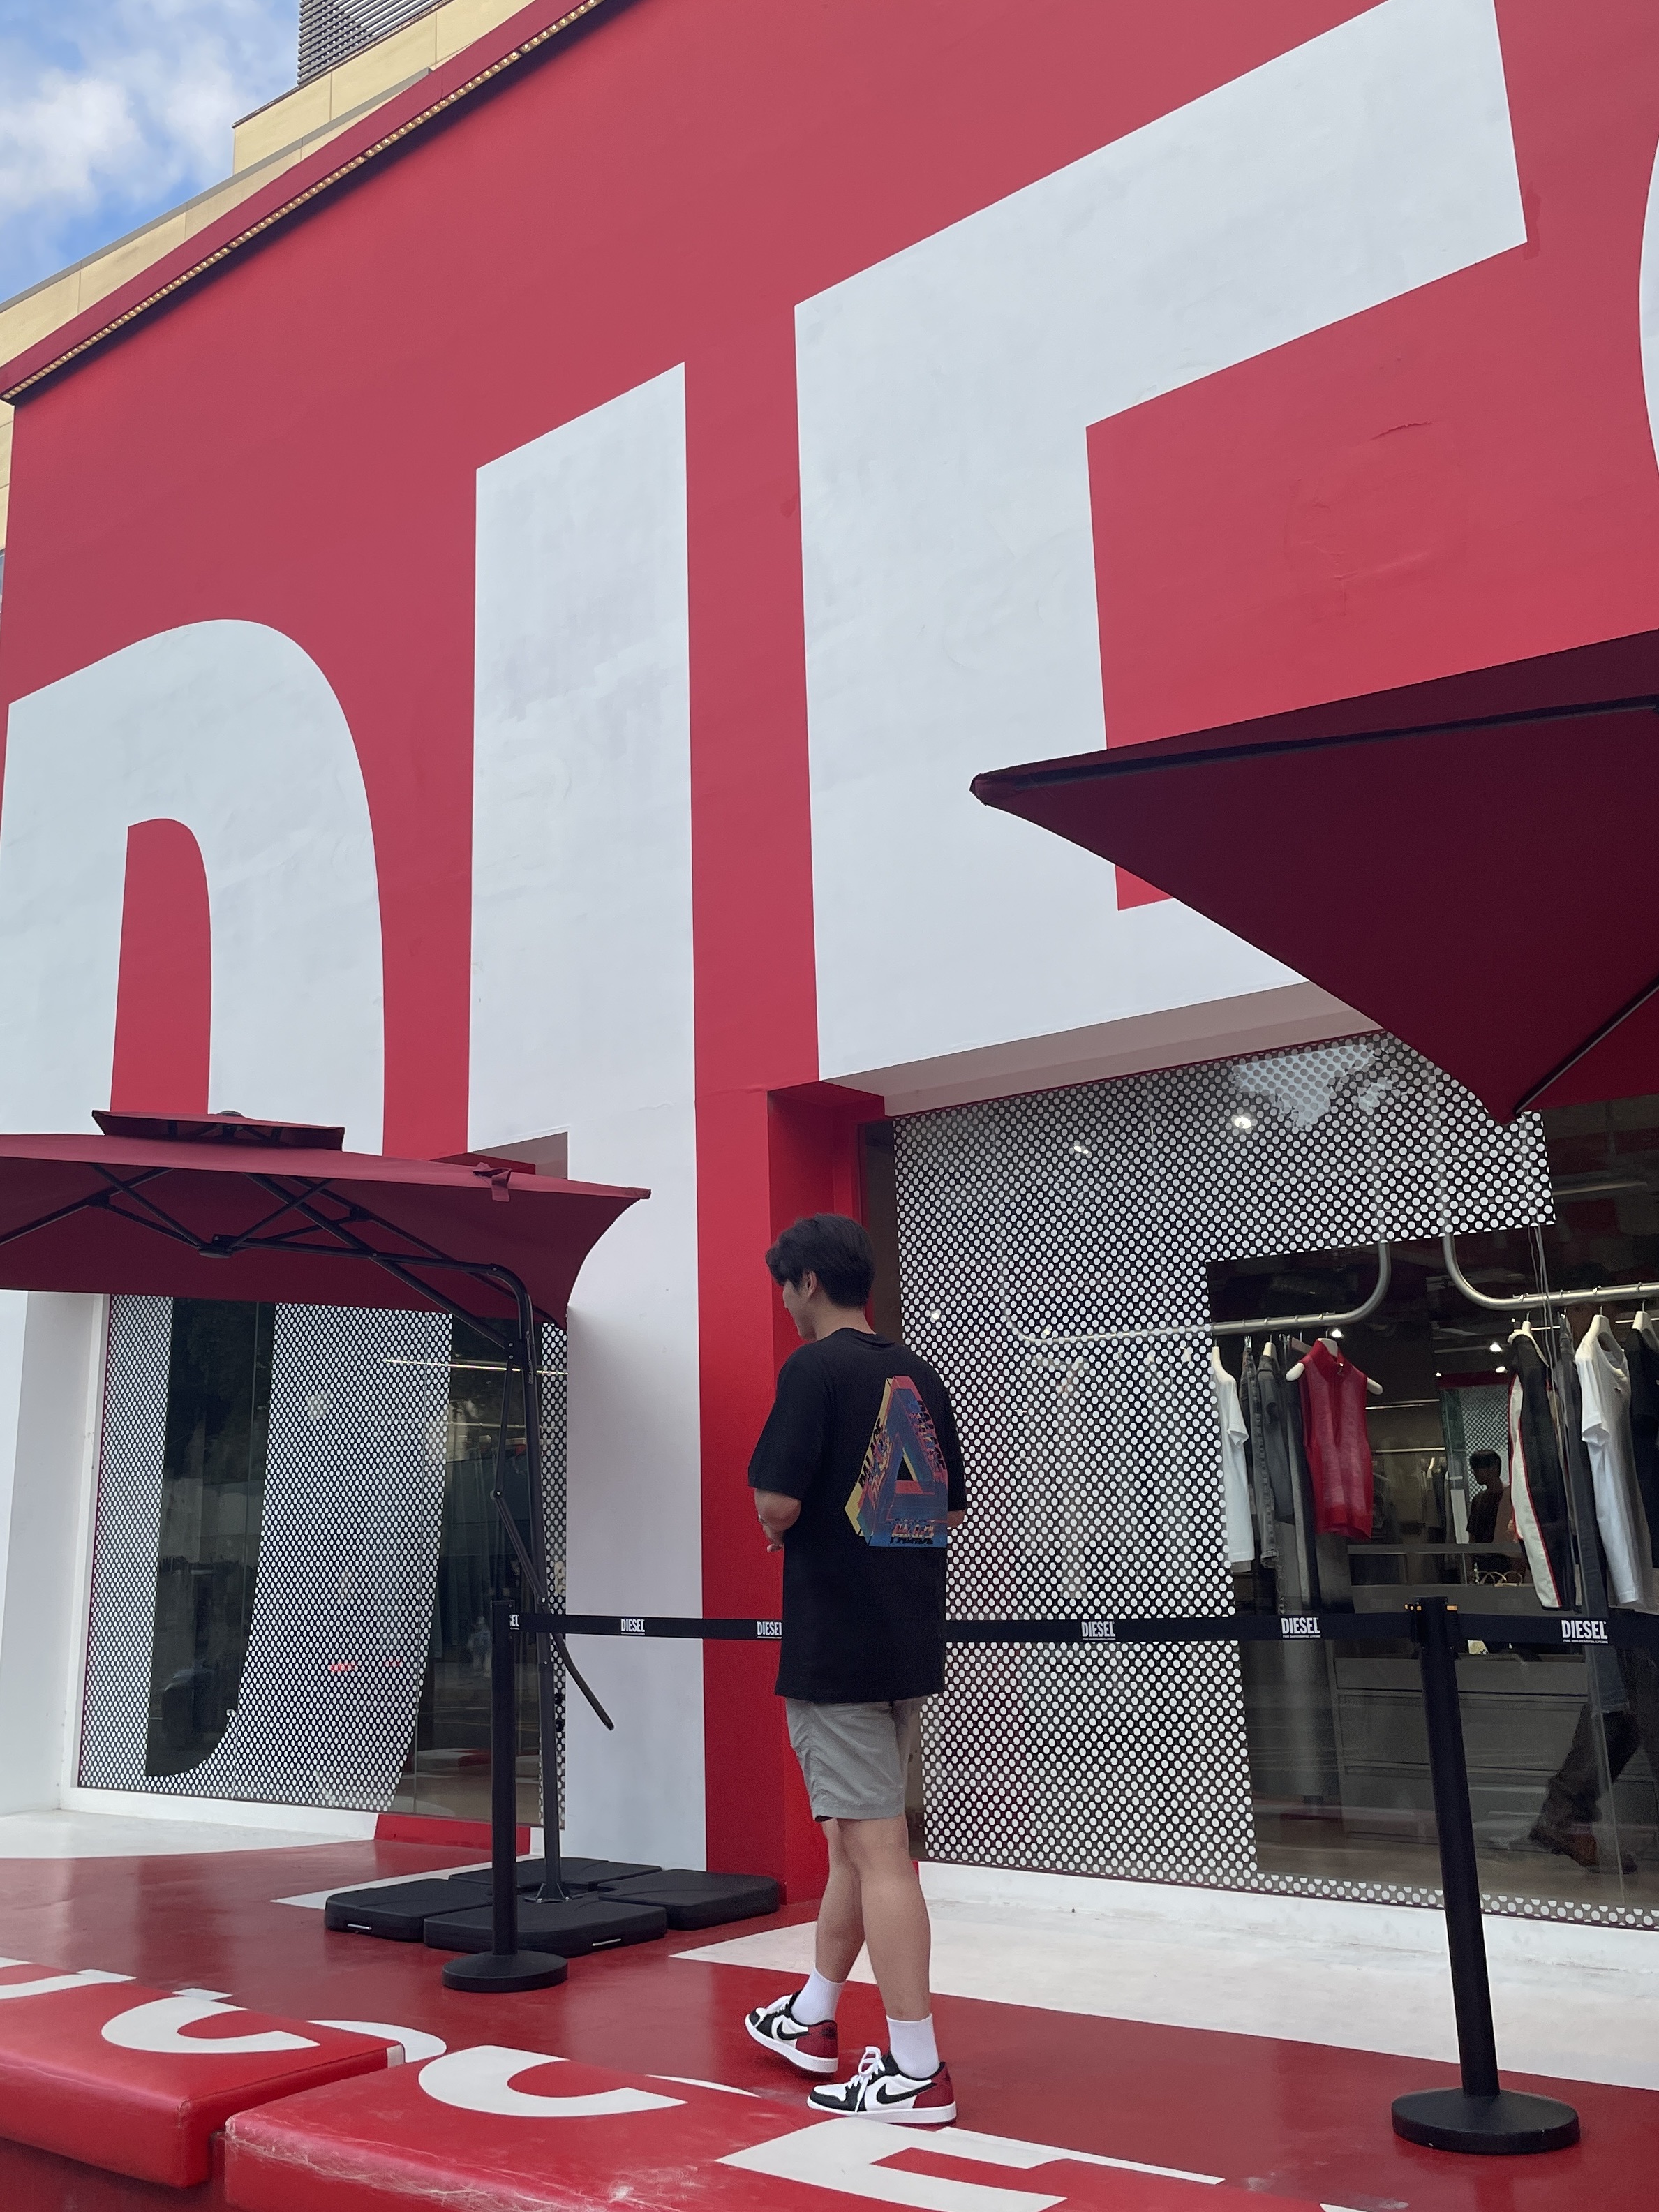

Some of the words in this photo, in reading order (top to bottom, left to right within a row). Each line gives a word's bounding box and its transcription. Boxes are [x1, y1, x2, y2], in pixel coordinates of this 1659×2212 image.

[620, 1618, 646, 1633] DIESEL
[1081, 1621, 1116, 1638] DIESEL
[1281, 1617, 1321, 1635] DIESEL
[1561, 1619, 1608, 1640] DIESEL
